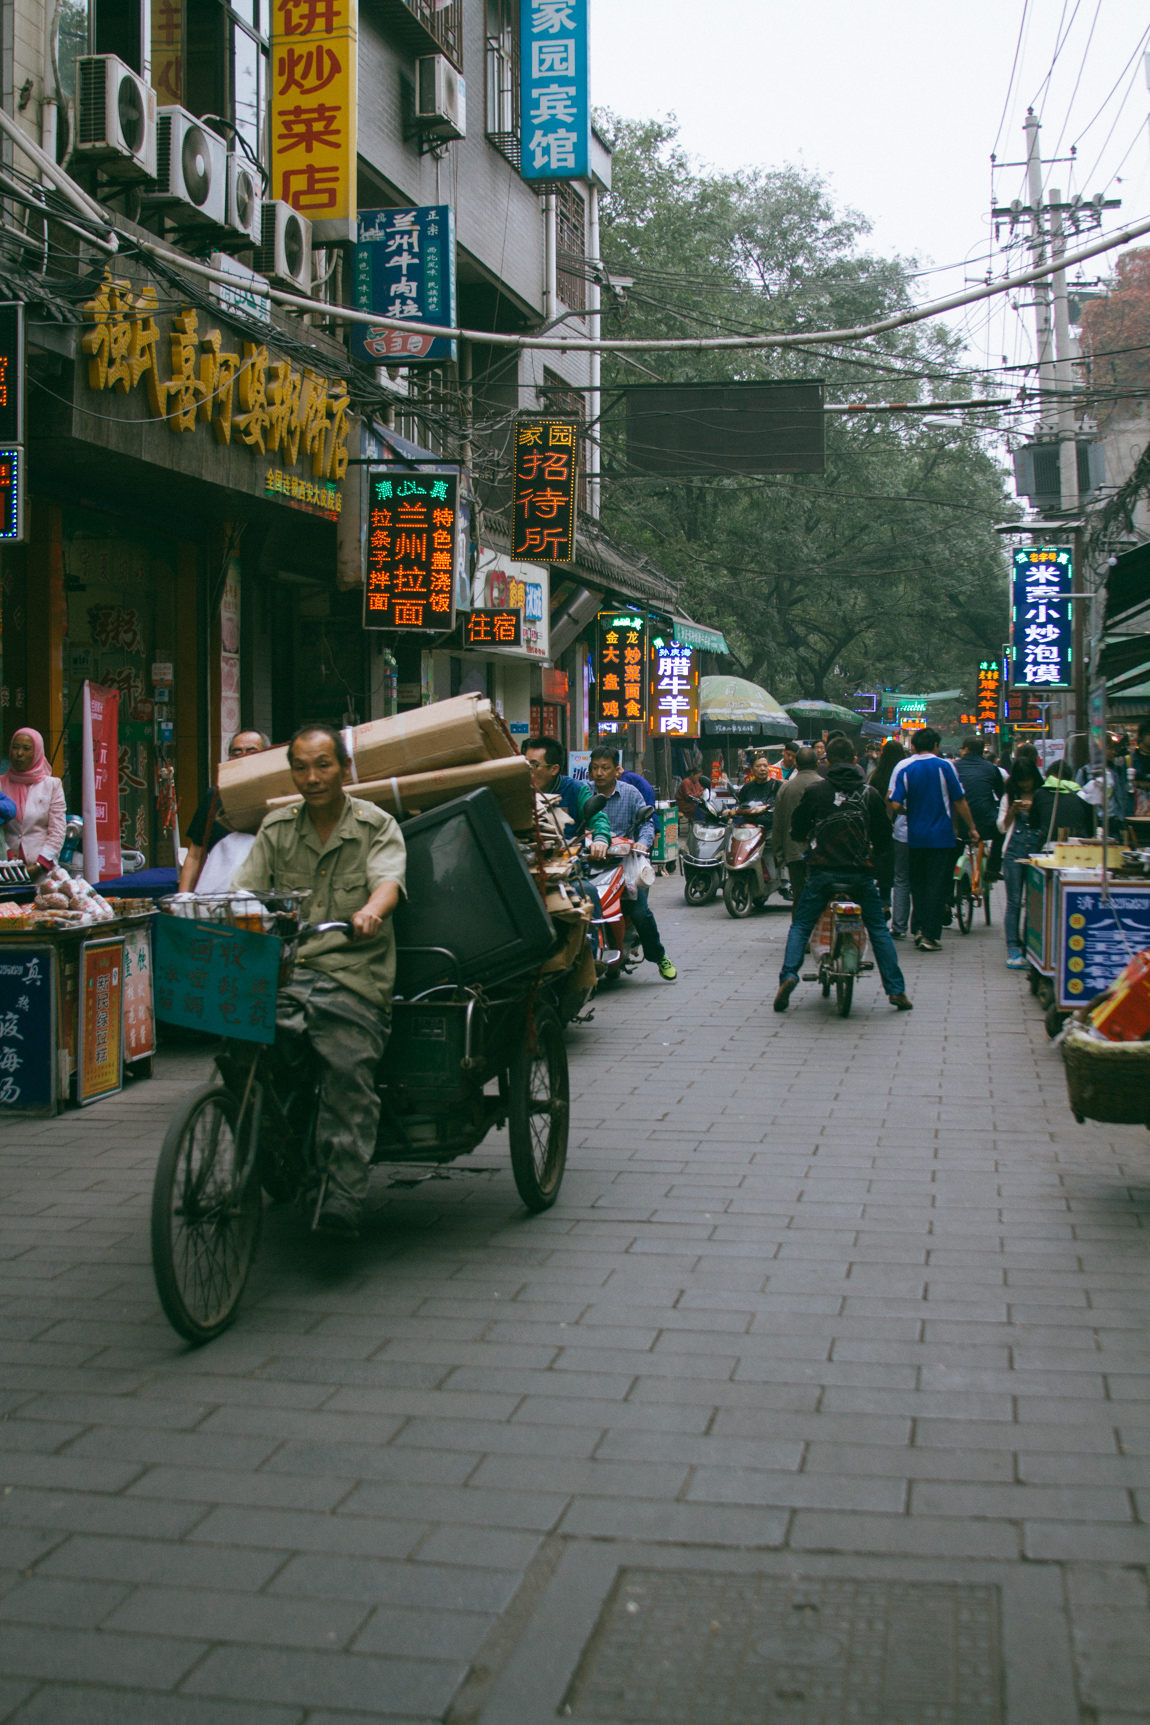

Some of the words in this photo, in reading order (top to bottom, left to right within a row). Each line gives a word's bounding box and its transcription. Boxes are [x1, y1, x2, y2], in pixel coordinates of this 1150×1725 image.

[277, 0, 342, 211] 饼炒菜店
[529, 0, 577, 169] 家园宾馆
[426, 210, 439, 236] 正宗
[519, 424, 572, 447] 家园
[516, 448, 569, 559] 招待所
[368, 508, 393, 610] 拉条子拌面
[391, 501, 428, 626] 兰州拉面
[429, 507, 454, 612] 特色盖浇饭
[468, 612, 516, 641] 住宿
[1023, 565, 1061, 683] 米家小炒泡馍
[602, 645, 620, 717] 大盘鸡
[624, 646, 641, 717] 炒菜面食
[657, 657, 692, 733] 腊牛羊肉
[191, 938, 246, 971] 回收
